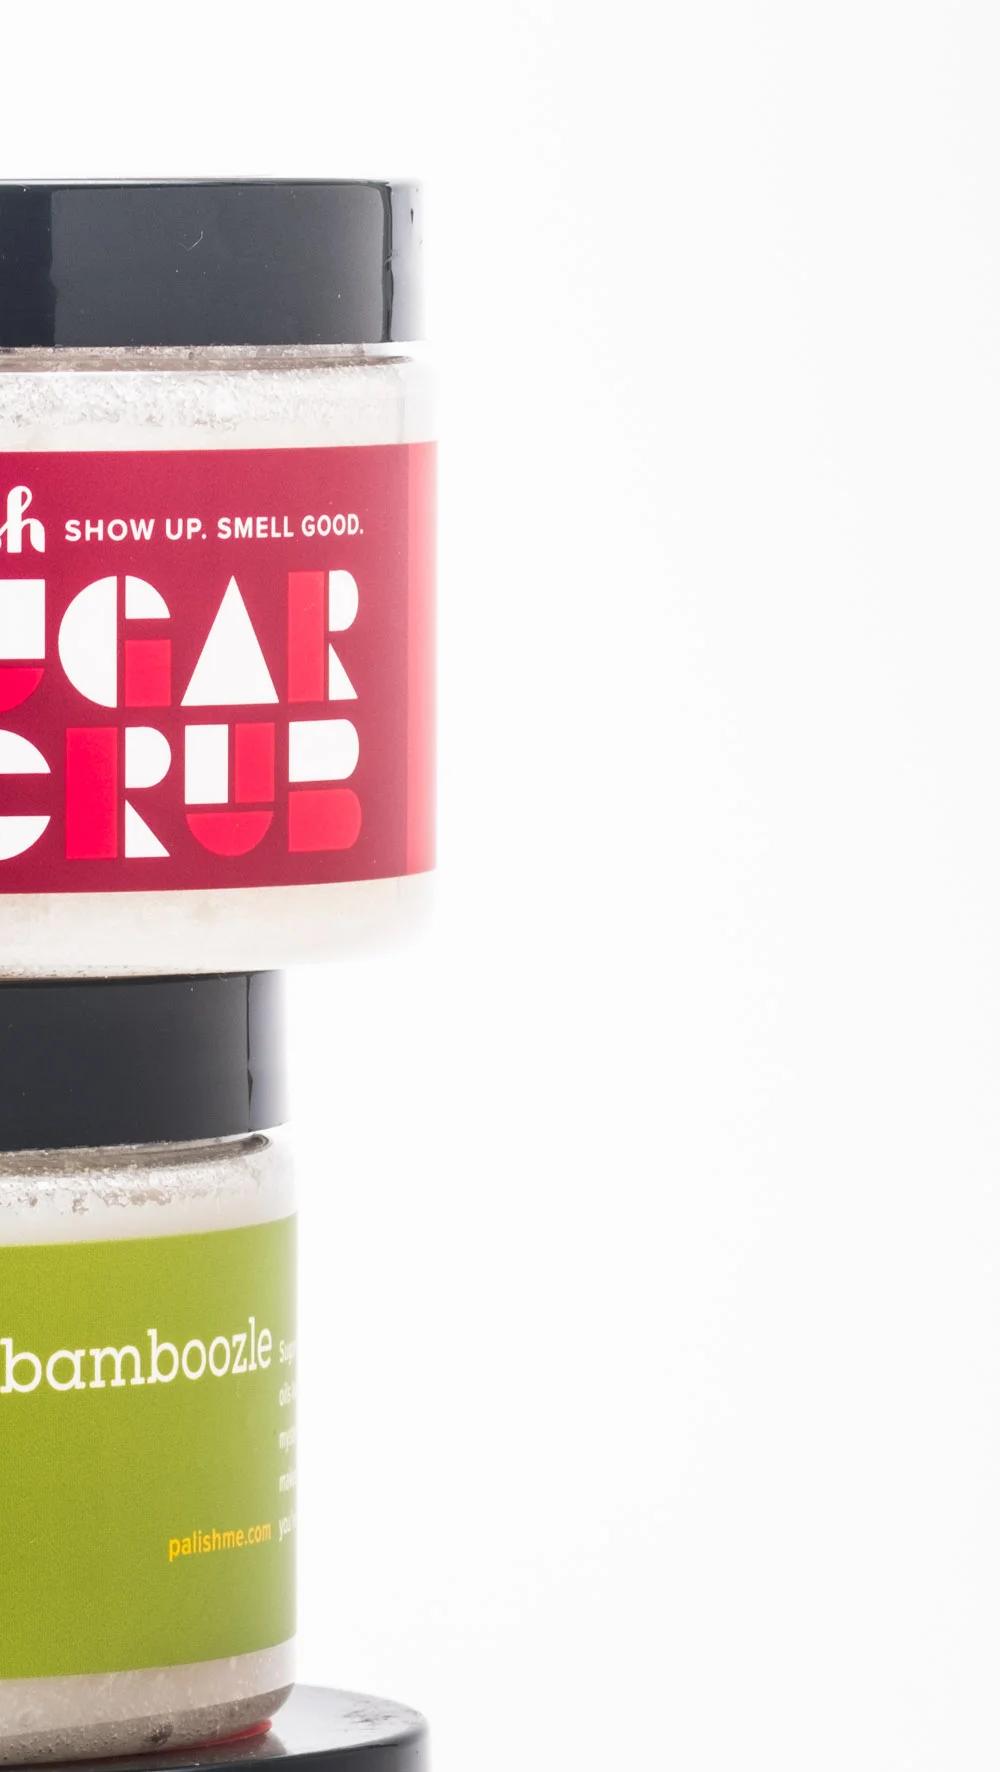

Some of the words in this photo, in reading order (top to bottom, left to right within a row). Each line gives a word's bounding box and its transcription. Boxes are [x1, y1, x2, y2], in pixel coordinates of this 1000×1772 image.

[65, 519, 155, 541] SHOW
[166, 518, 206, 540] UP.
[218, 516, 294, 539] SMELL
[302, 514, 363, 537] GOOD.
[0, 1316, 272, 1394] bamboozle
[168, 1523, 272, 1561] palishme.com
